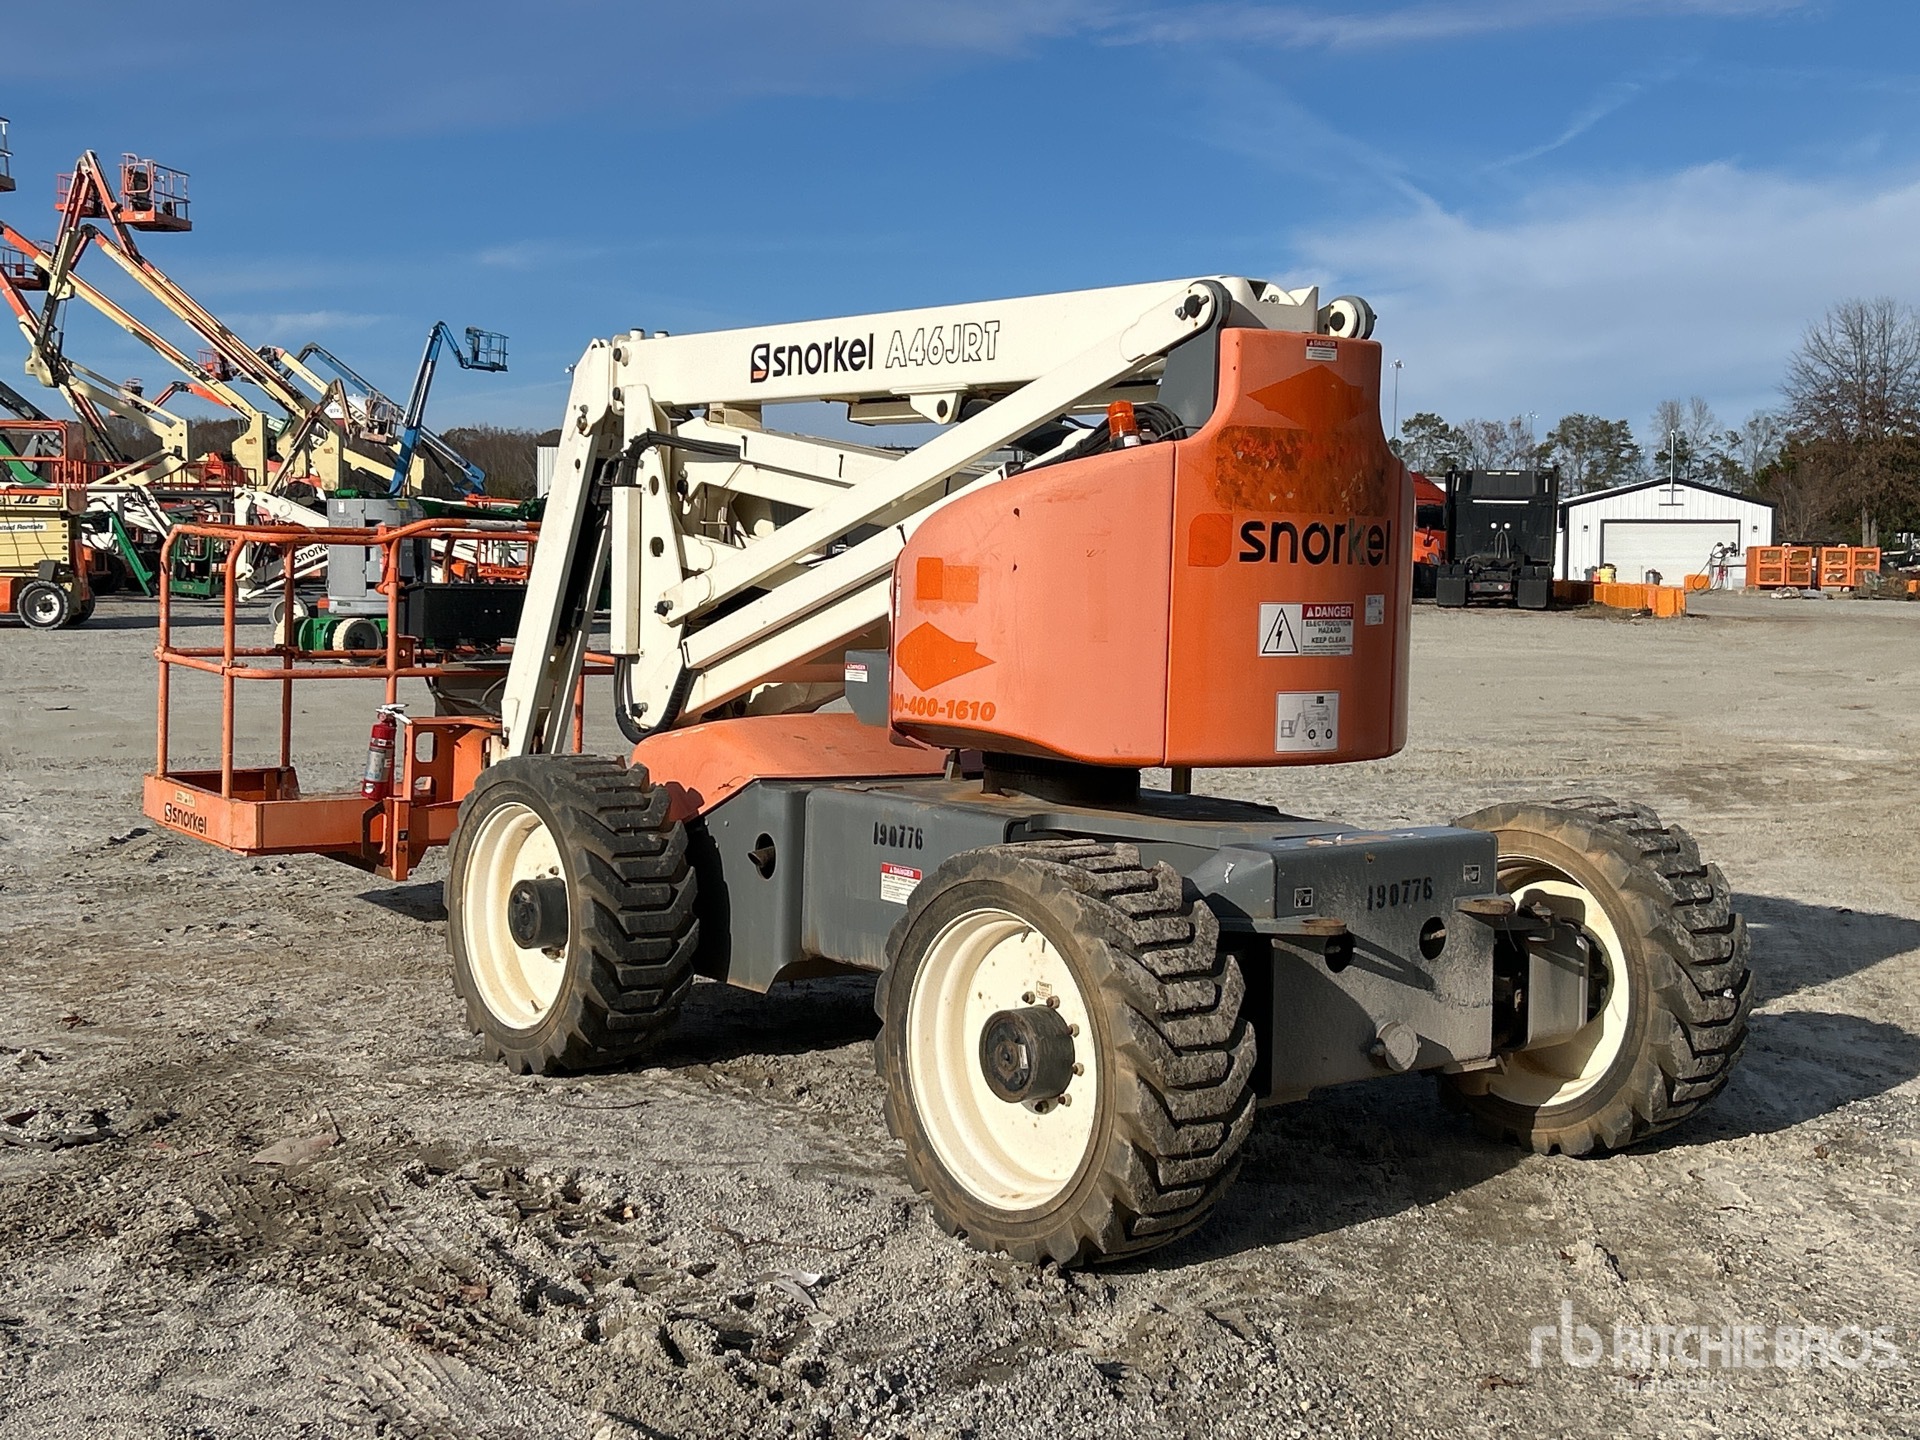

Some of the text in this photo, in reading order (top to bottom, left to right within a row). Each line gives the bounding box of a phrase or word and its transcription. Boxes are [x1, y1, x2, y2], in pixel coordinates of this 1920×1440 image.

[773, 320, 1000, 377] snorkel A46JRT
[14, 495, 39, 504] JLG
[295, 543, 329, 564] snorke
[1239, 520, 1391, 567] snorkel
[1314, 605, 1352, 618] DANGER
[1311, 636, 1328, 644] KEEP
[1317, 626, 1342, 634] HAZARD
[172, 806, 208, 835] snorkel
[873, 821, 924, 851] 190776
[1367, 876, 1433, 911] 190776
